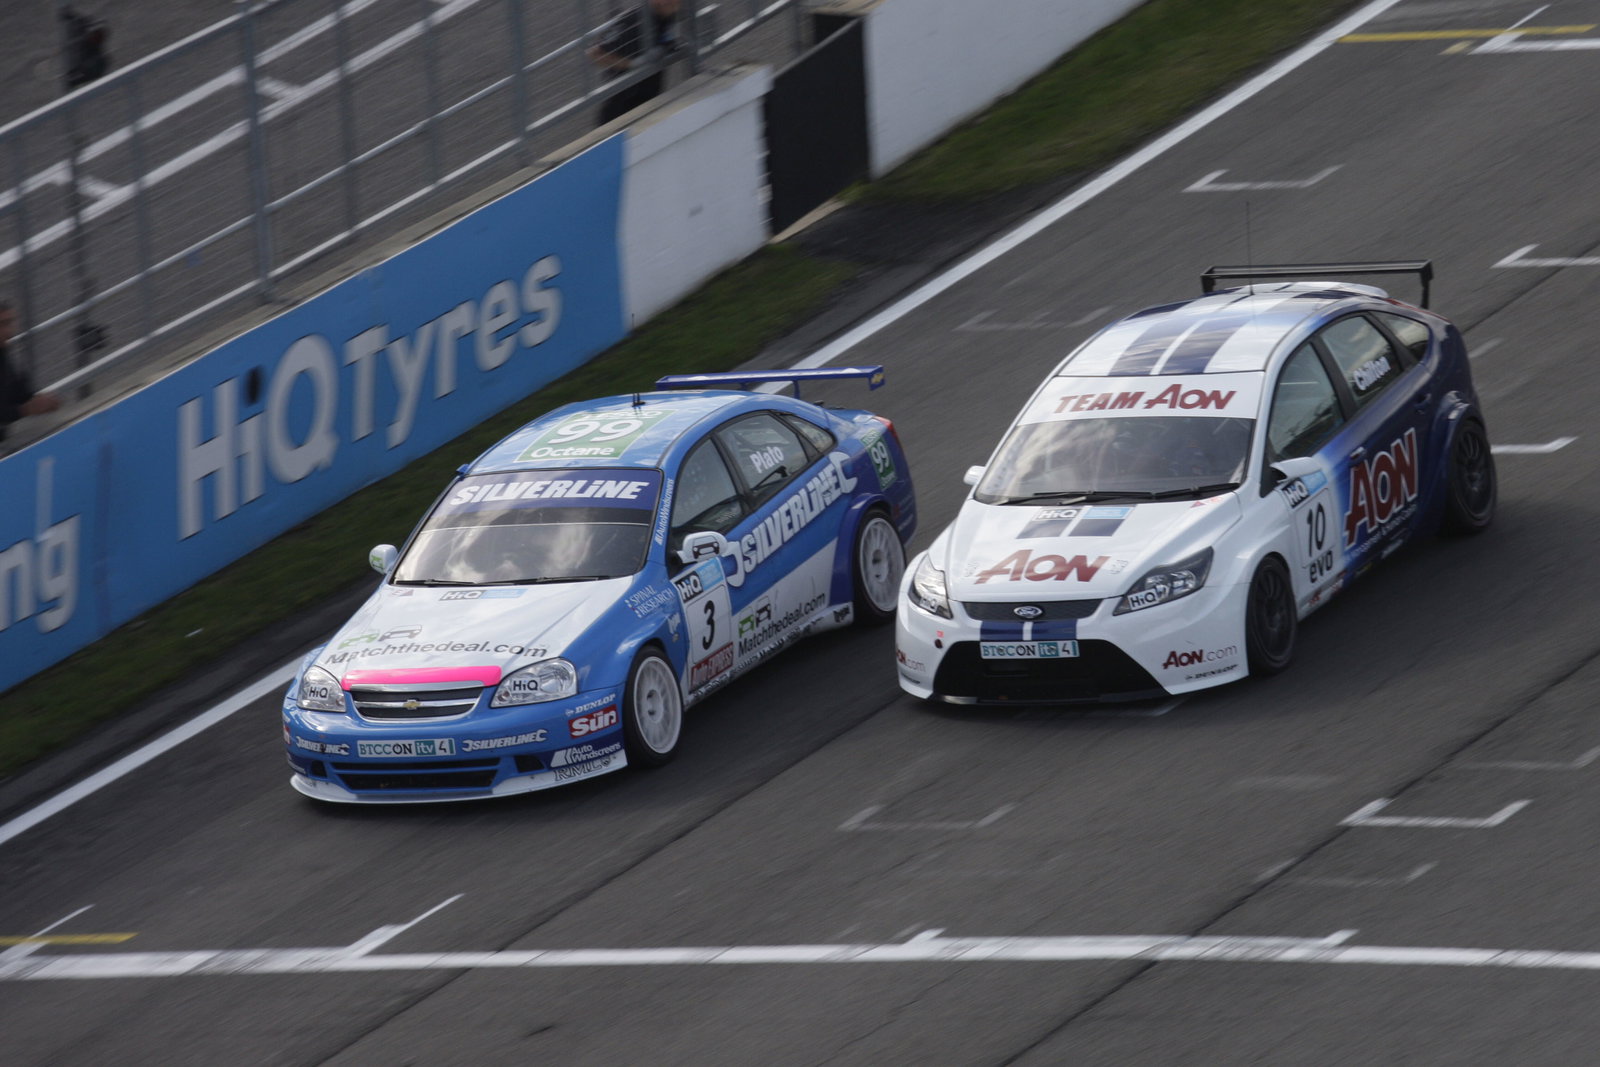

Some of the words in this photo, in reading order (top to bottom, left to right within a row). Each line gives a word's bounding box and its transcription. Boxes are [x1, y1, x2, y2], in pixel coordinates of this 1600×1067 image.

[177, 334, 339, 541] HiQ
[344, 254, 562, 451] Tyres
[1055, 391, 1146, 414] TEAM
[548, 419, 644, 444] 99
[531, 447, 615, 459] Octane
[750, 445, 784, 474] Plato
[870, 441, 890, 473] 99
[1038, 508, 1077, 520] HiQ
[1306, 501, 1326, 558] 10
[1309, 549, 1333, 583] evo
[442, 590, 482, 600] HiQ
[629, 584, 658, 607] SPINAL
[637, 587, 675, 616] RESEARCH
[1130, 591, 1156, 608] HiQ
[702, 600, 715, 651] 3
[325, 641, 548, 665] Matchthedeal.com
[308, 686, 328, 699] HiQ
[513, 679, 539, 692] HiQ
[575, 693, 616, 714] DUNLOP
[571, 710, 617, 737] Sun
[416, 740, 434, 754] itv
[438, 740, 447, 753] 4
[572, 744, 593, 755] Auto
[573, 742, 621, 762] Windscreens
